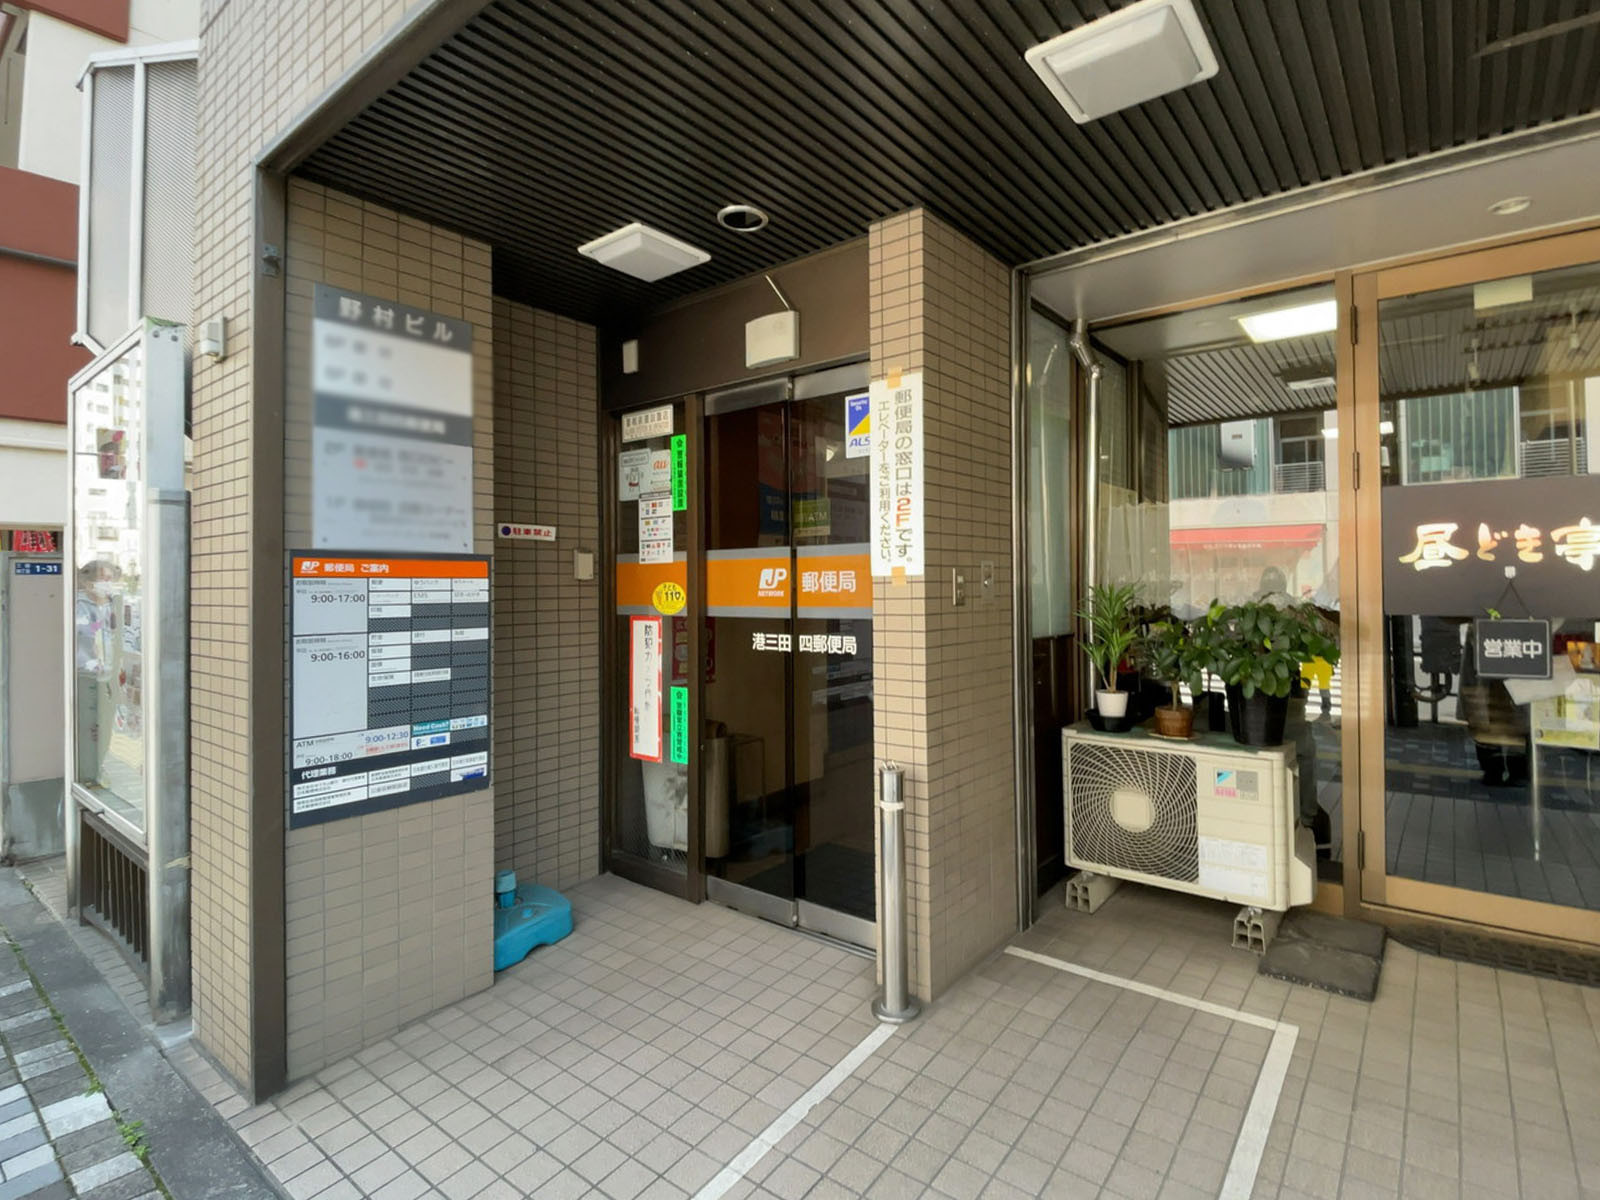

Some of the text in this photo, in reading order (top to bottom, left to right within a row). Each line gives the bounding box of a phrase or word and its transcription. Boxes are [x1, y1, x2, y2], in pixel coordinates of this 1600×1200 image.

[339, 296, 453, 342] 野村ビル
[878, 401, 892, 562] エレベーターをご利用ください。
[895, 389, 913, 562] 郵便局の窓口は2Fです。
[513, 527, 553, 537] 駐車禁止
[1398, 517, 1600, 571] 昼どき亭
[36, 565, 58, 573] 1-31
[324, 563, 355, 573] 郵便局
[360, 564, 389, 574] ご案内
[802, 570, 857, 593] 郵便局
[311, 594, 366, 604] 9:00-17:00
[752, 632, 858, 656] 港三田四郵便局
[1483, 638, 1543, 660] 営業中
[311, 650, 366, 663] 9:00-16:00
[296, 738, 314, 748] ATM
[365, 731, 409, 743] 9:00-12:30
[305, 751, 353, 766] 9:00-18:00
